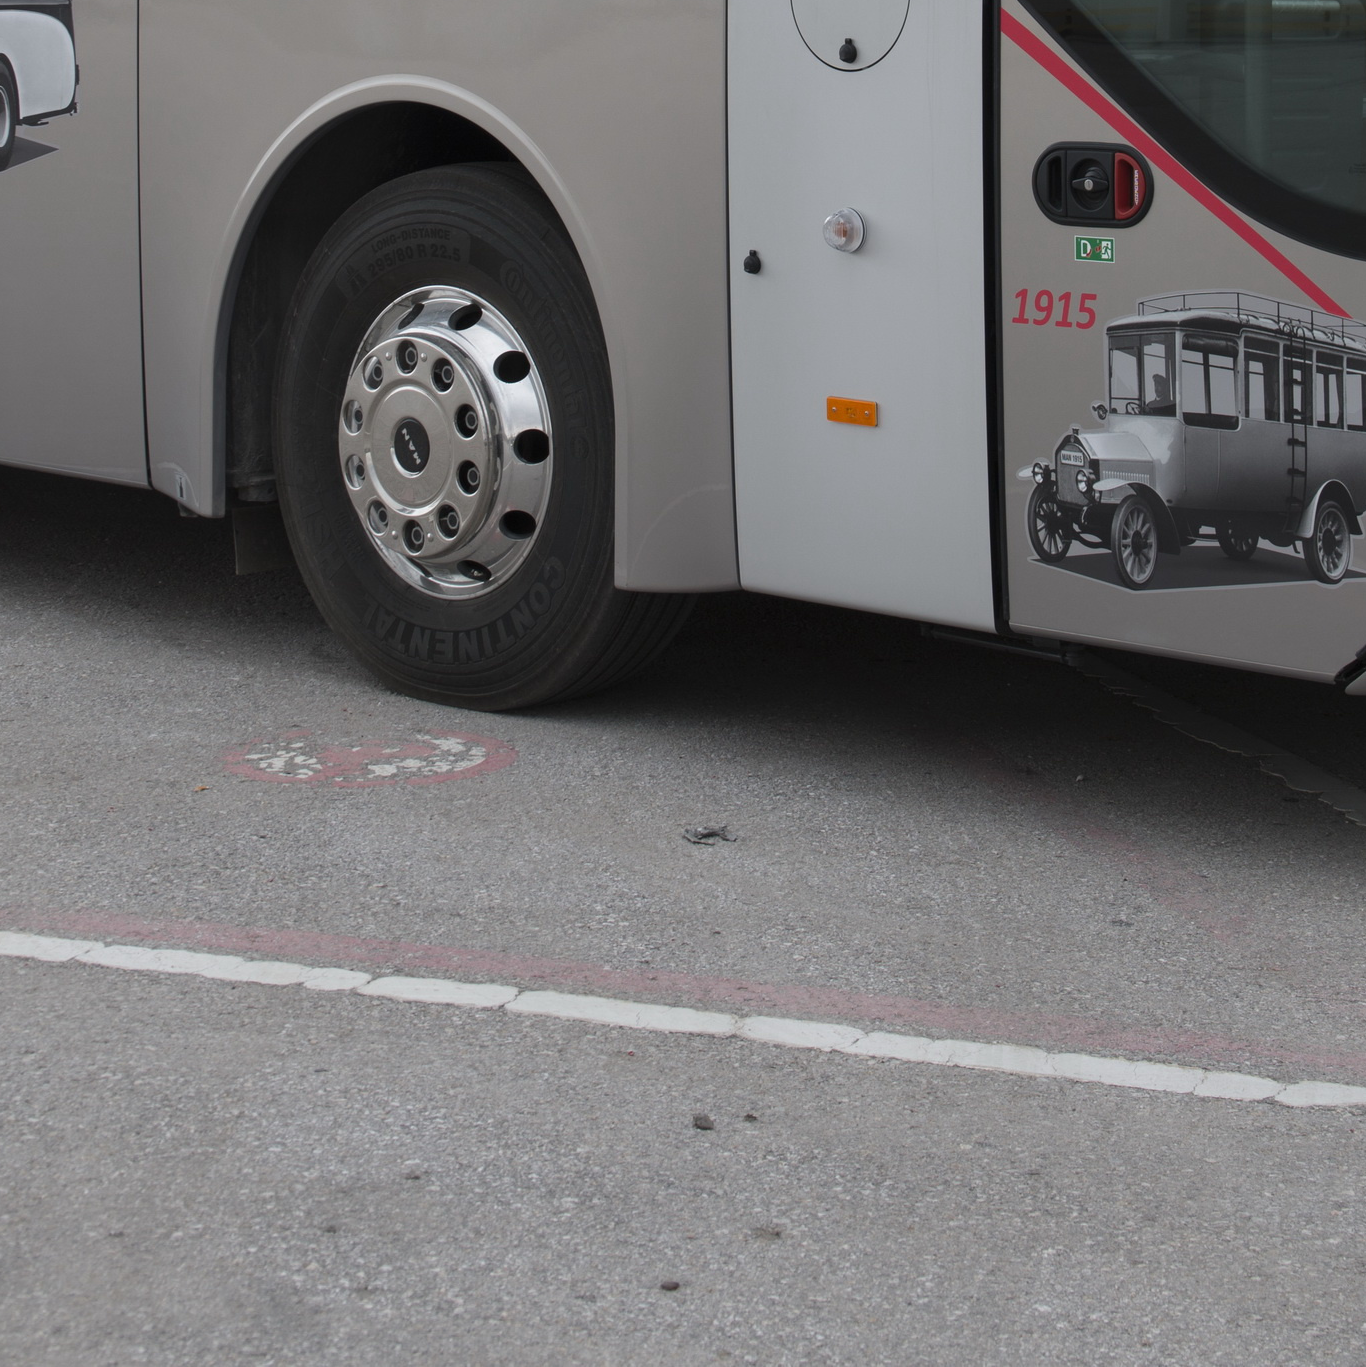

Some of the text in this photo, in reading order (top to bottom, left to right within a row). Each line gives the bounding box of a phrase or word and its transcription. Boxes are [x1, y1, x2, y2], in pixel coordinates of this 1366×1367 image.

[371, 227, 451, 254] LONG-DISTANCE
[368, 243, 461, 278] 295/80 R 22.5
[1012, 288, 1097, 330] 1915
[401, 428, 421, 465] MAN
[1061, 453, 1083, 464] MAN 1915
[361, 555, 567, 666] CONTINENTAL
